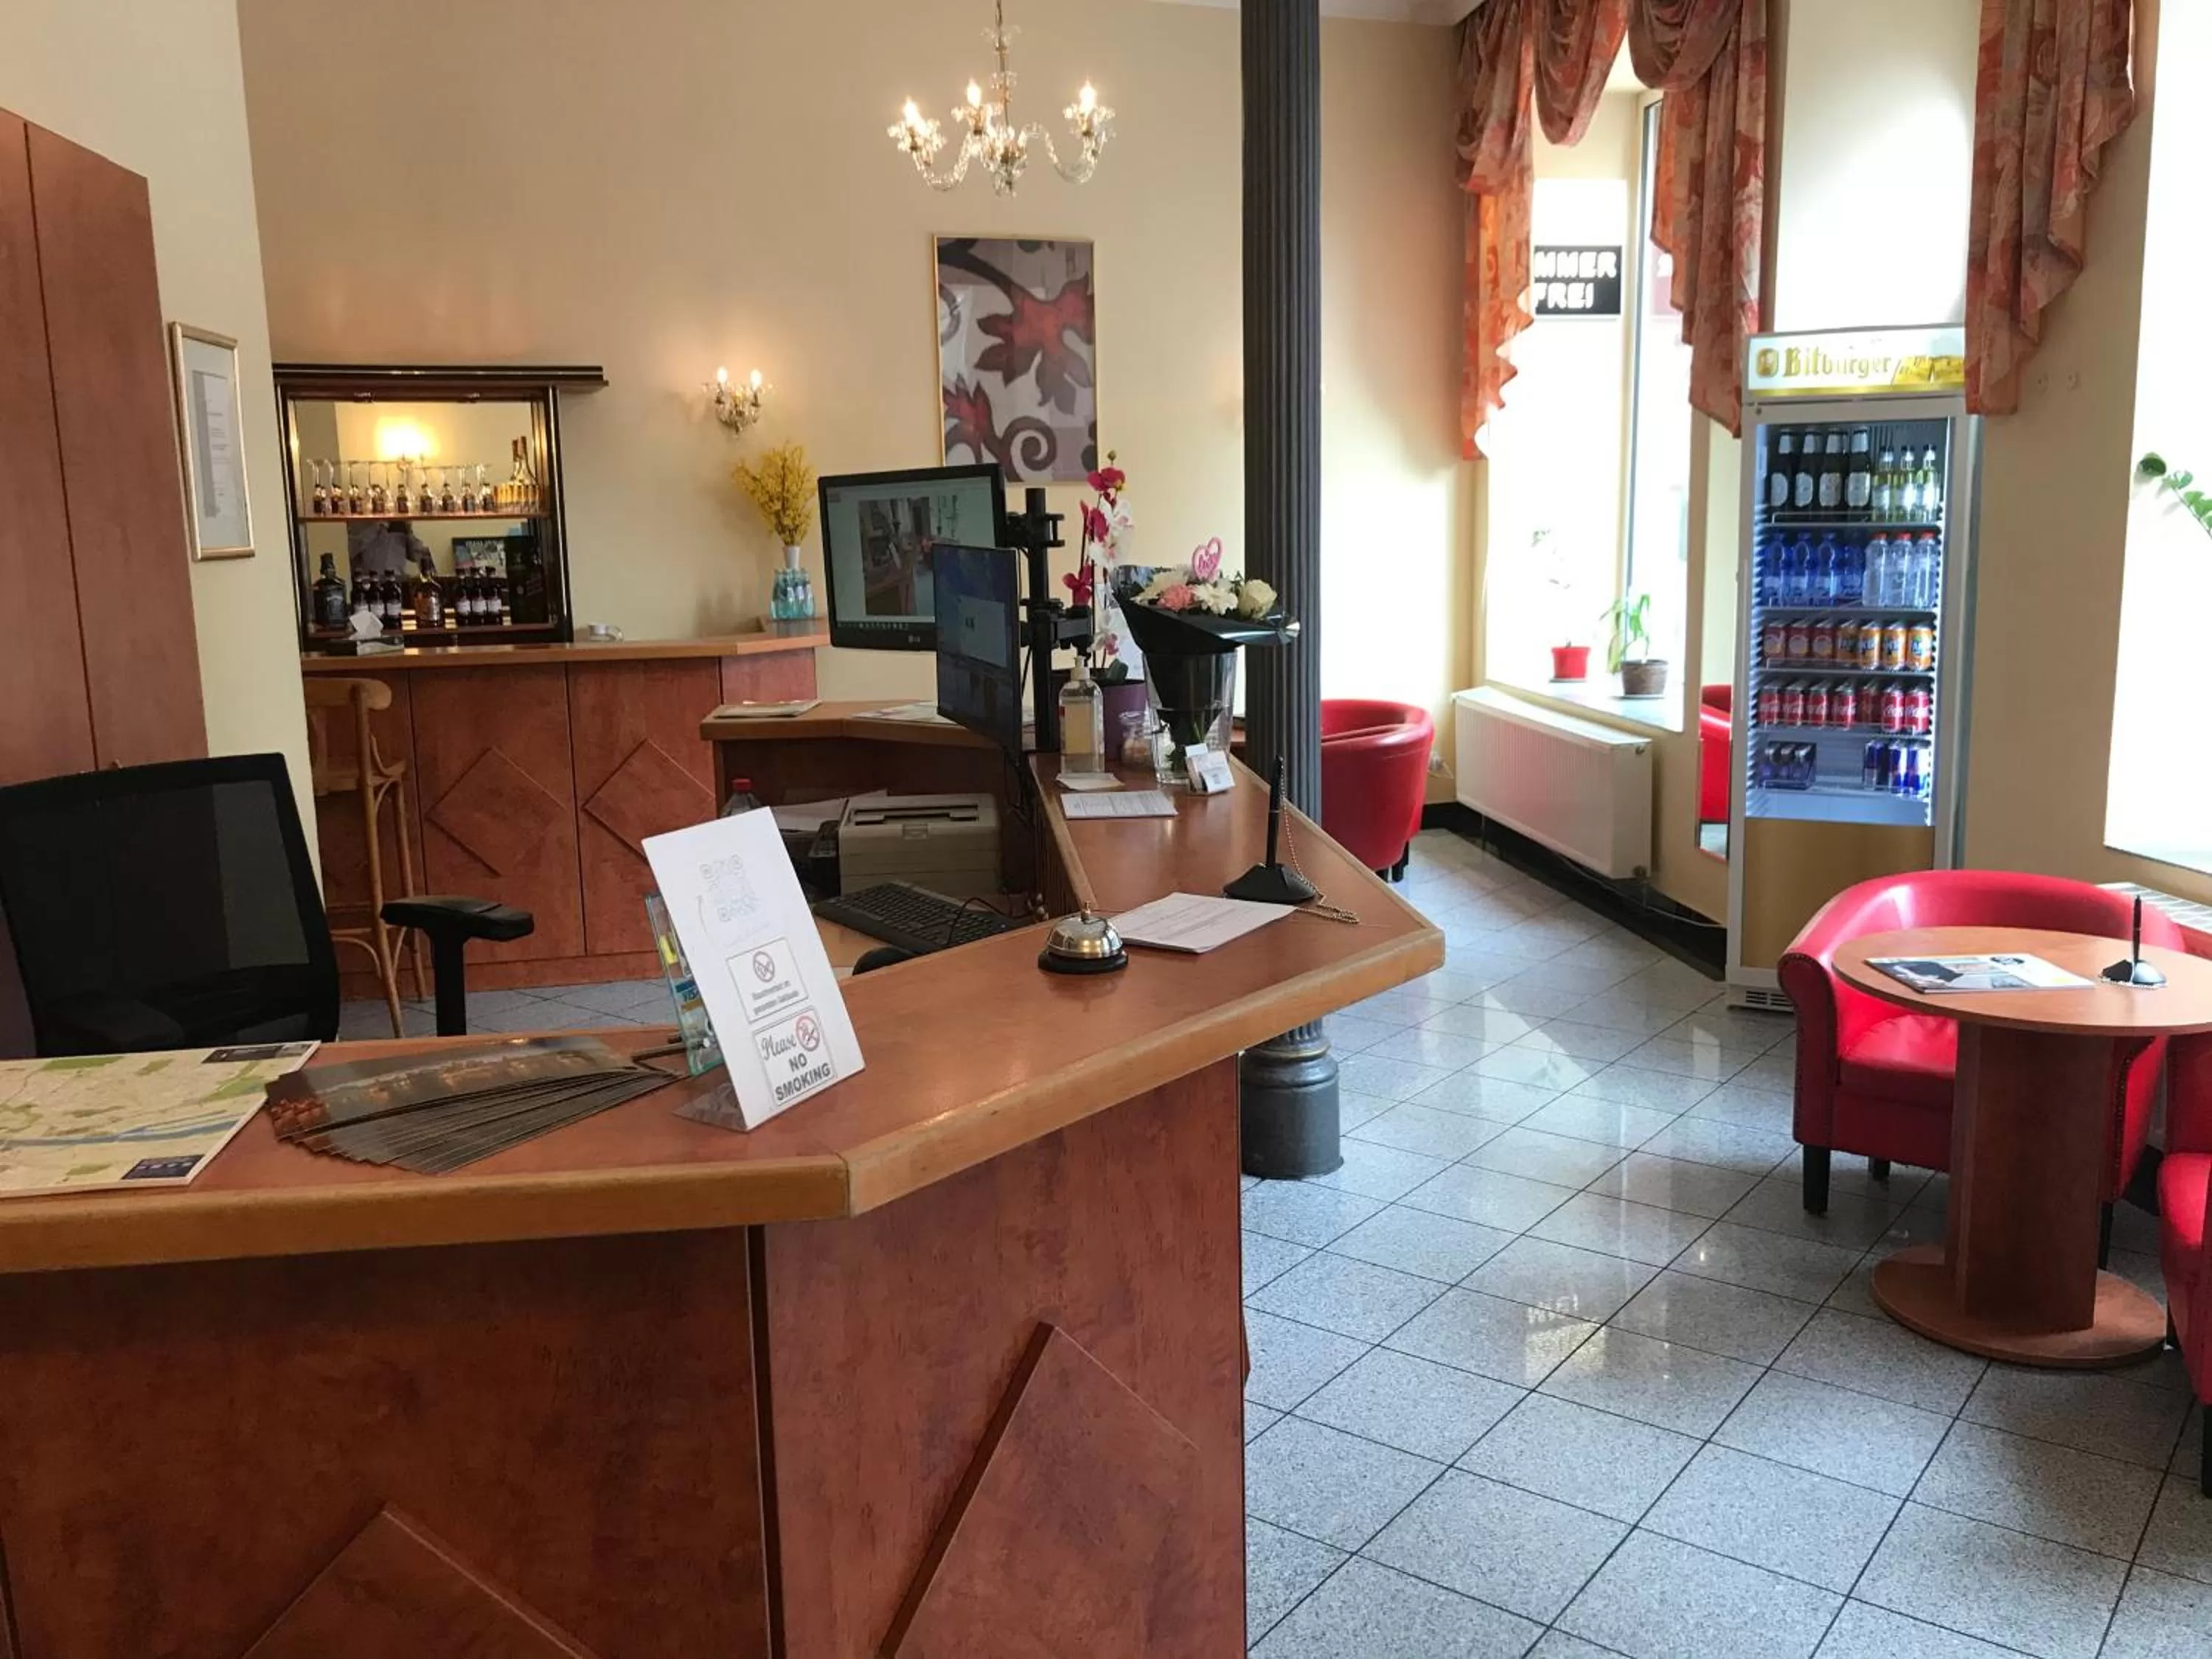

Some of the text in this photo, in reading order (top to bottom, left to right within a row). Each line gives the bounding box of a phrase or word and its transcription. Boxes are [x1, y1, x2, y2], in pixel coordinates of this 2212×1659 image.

[1534, 251, 1617, 278] MMER
[1782, 346, 1892, 379] Bitburger
[761, 1034, 797, 1061] Please
[788, 1053, 808, 1072] NO
[775, 1062, 831, 1101] SMOKING
